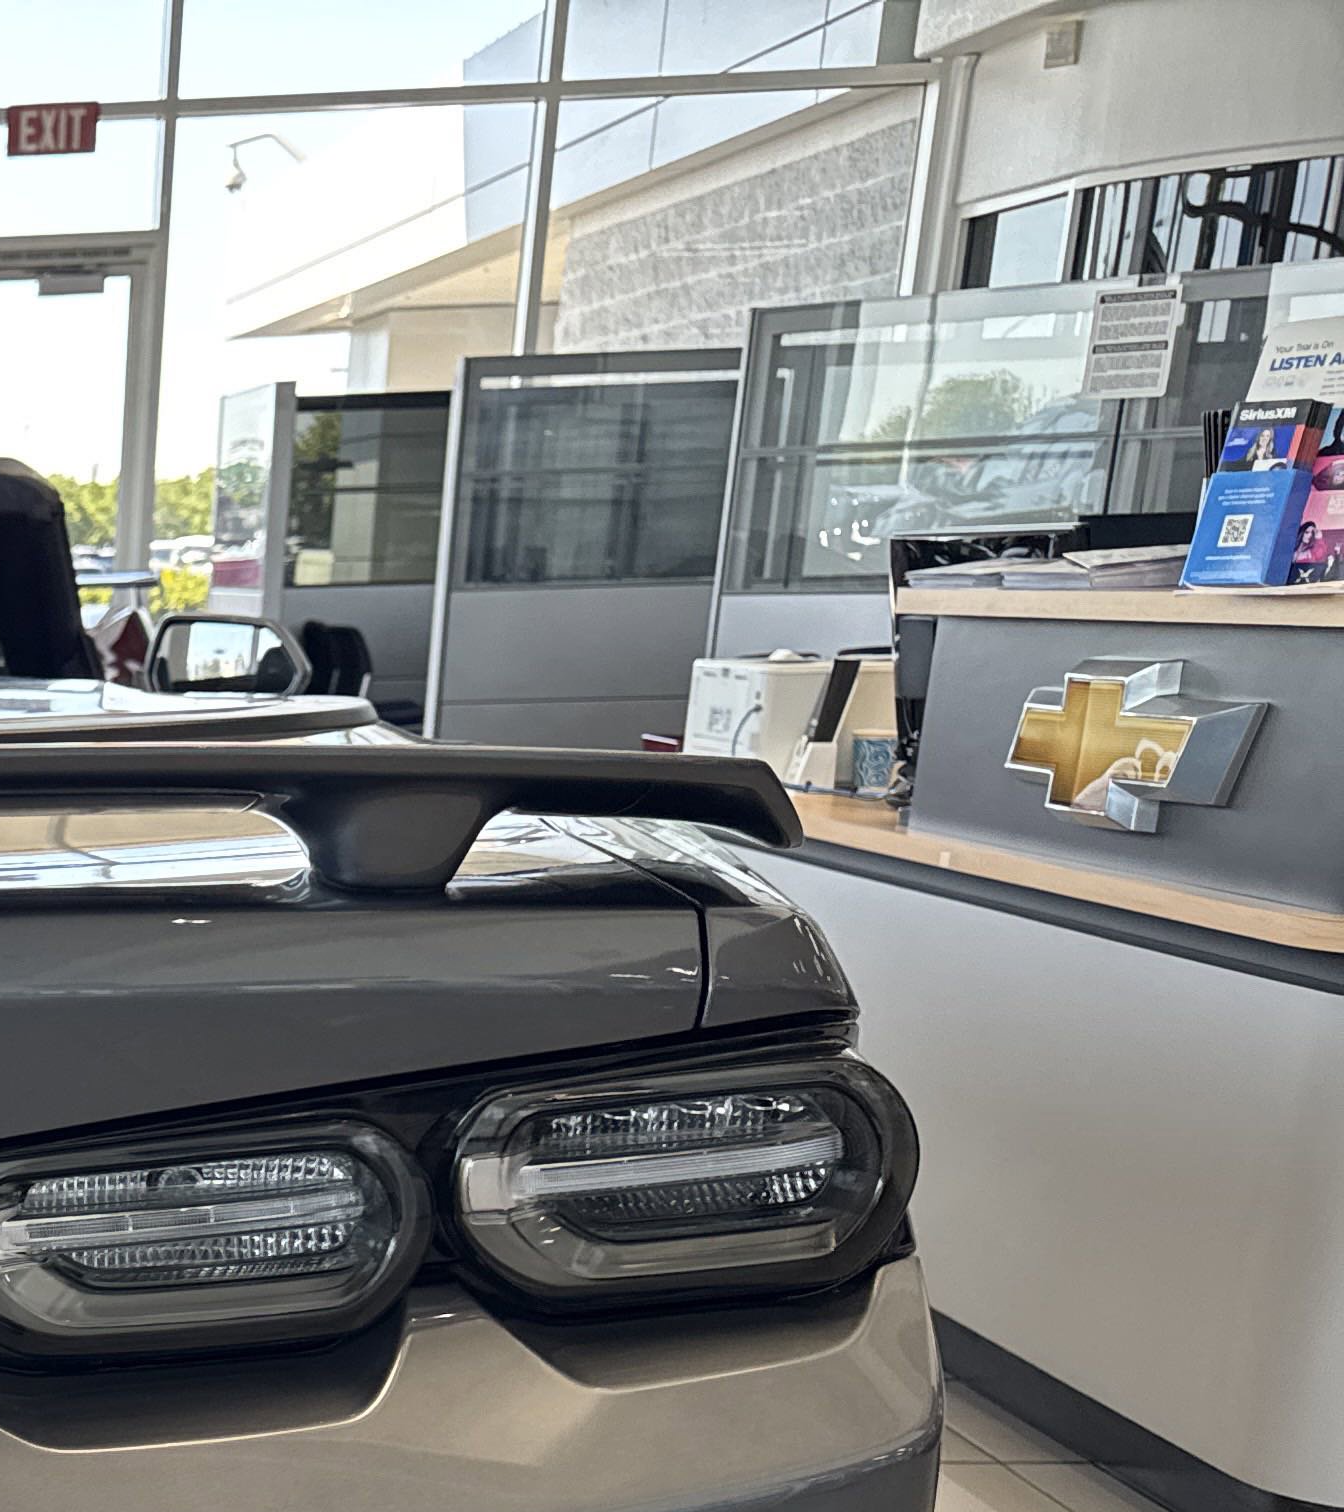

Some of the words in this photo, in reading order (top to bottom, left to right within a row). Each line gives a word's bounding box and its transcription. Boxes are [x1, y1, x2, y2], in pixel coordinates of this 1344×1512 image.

[18, 107, 87, 152] EXIT
[1269, 354, 1328, 371] LISTEN
[1239, 407, 1297, 421] SiriusXM
